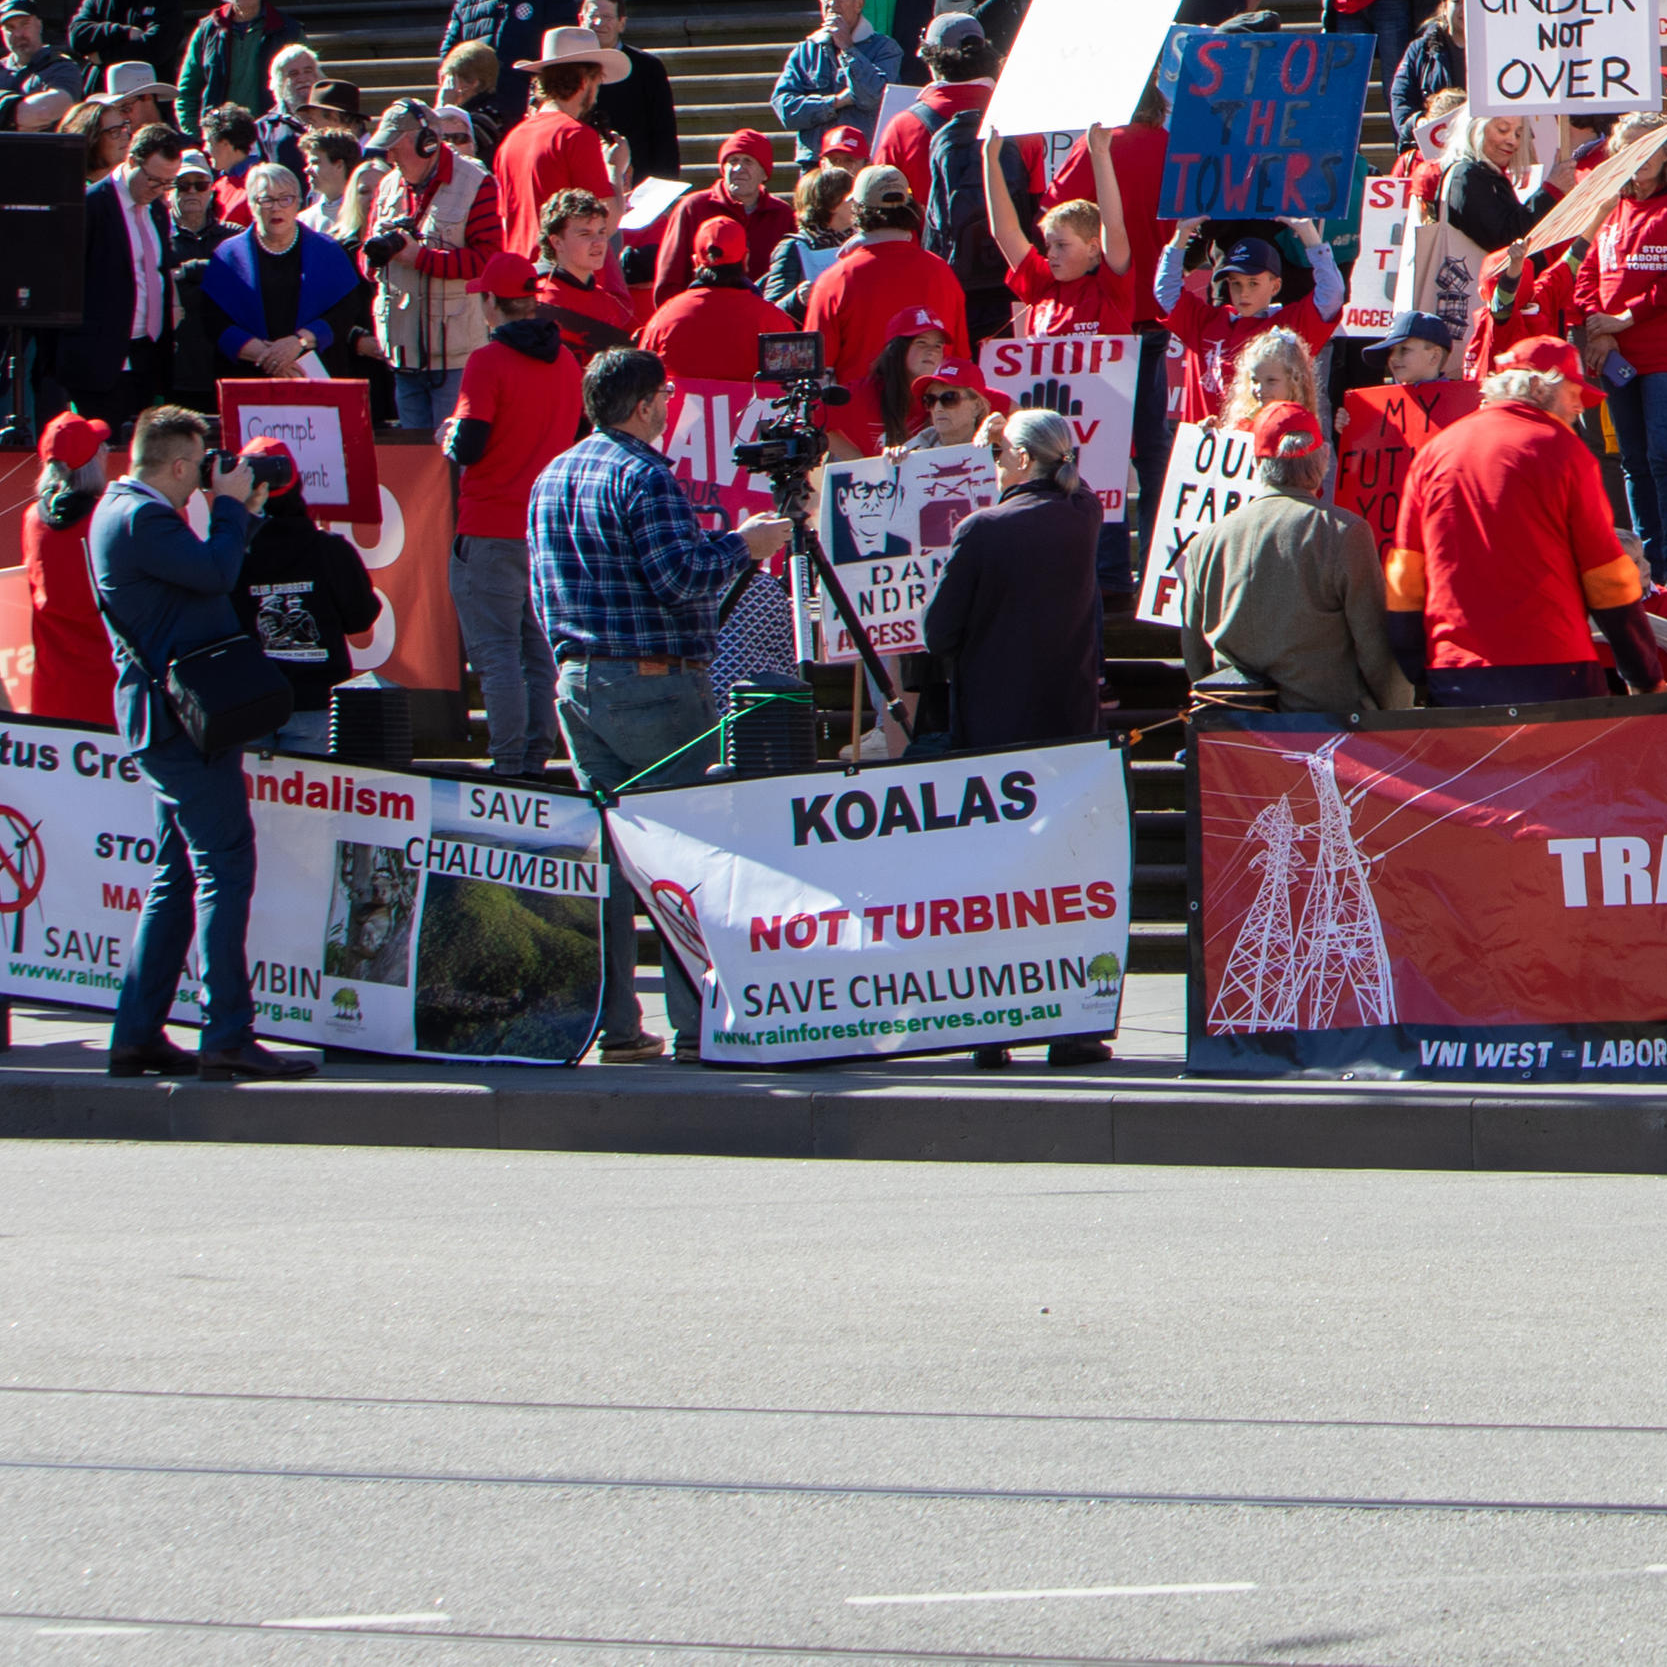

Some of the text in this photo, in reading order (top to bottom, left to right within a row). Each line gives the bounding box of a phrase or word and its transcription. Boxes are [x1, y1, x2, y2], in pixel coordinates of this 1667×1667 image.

[1538, 20, 1595, 50] NOT
[1188, 40, 1355, 96] STOP
[1498, 57, 1639, 100] OVER
[1210, 101, 1311, 146] THE
[1171, 154, 1343, 213] TOWERS
[1073, 321, 1100, 331] STOP
[994, 339, 1124, 377] STOP
[247, 416, 316, 452] Corrupt
[1379, 393, 1440, 438] MY
[469, 788, 551, 830] SAVE
[791, 770, 1037, 847] KOALAS
[403, 836, 598, 894] CHALUMBIN
[749, 880, 1118, 953] NOT TURBINES
[44, 926, 122, 968] SAVE
[743, 955, 1089, 1019] SAVE CHALUMBIN
[713, 1000, 1063, 1048] www.rainforestreserves.org.au
[1420, 1041, 1466, 1068] VNI
[1475, 1041, 1554, 1068] WEST
